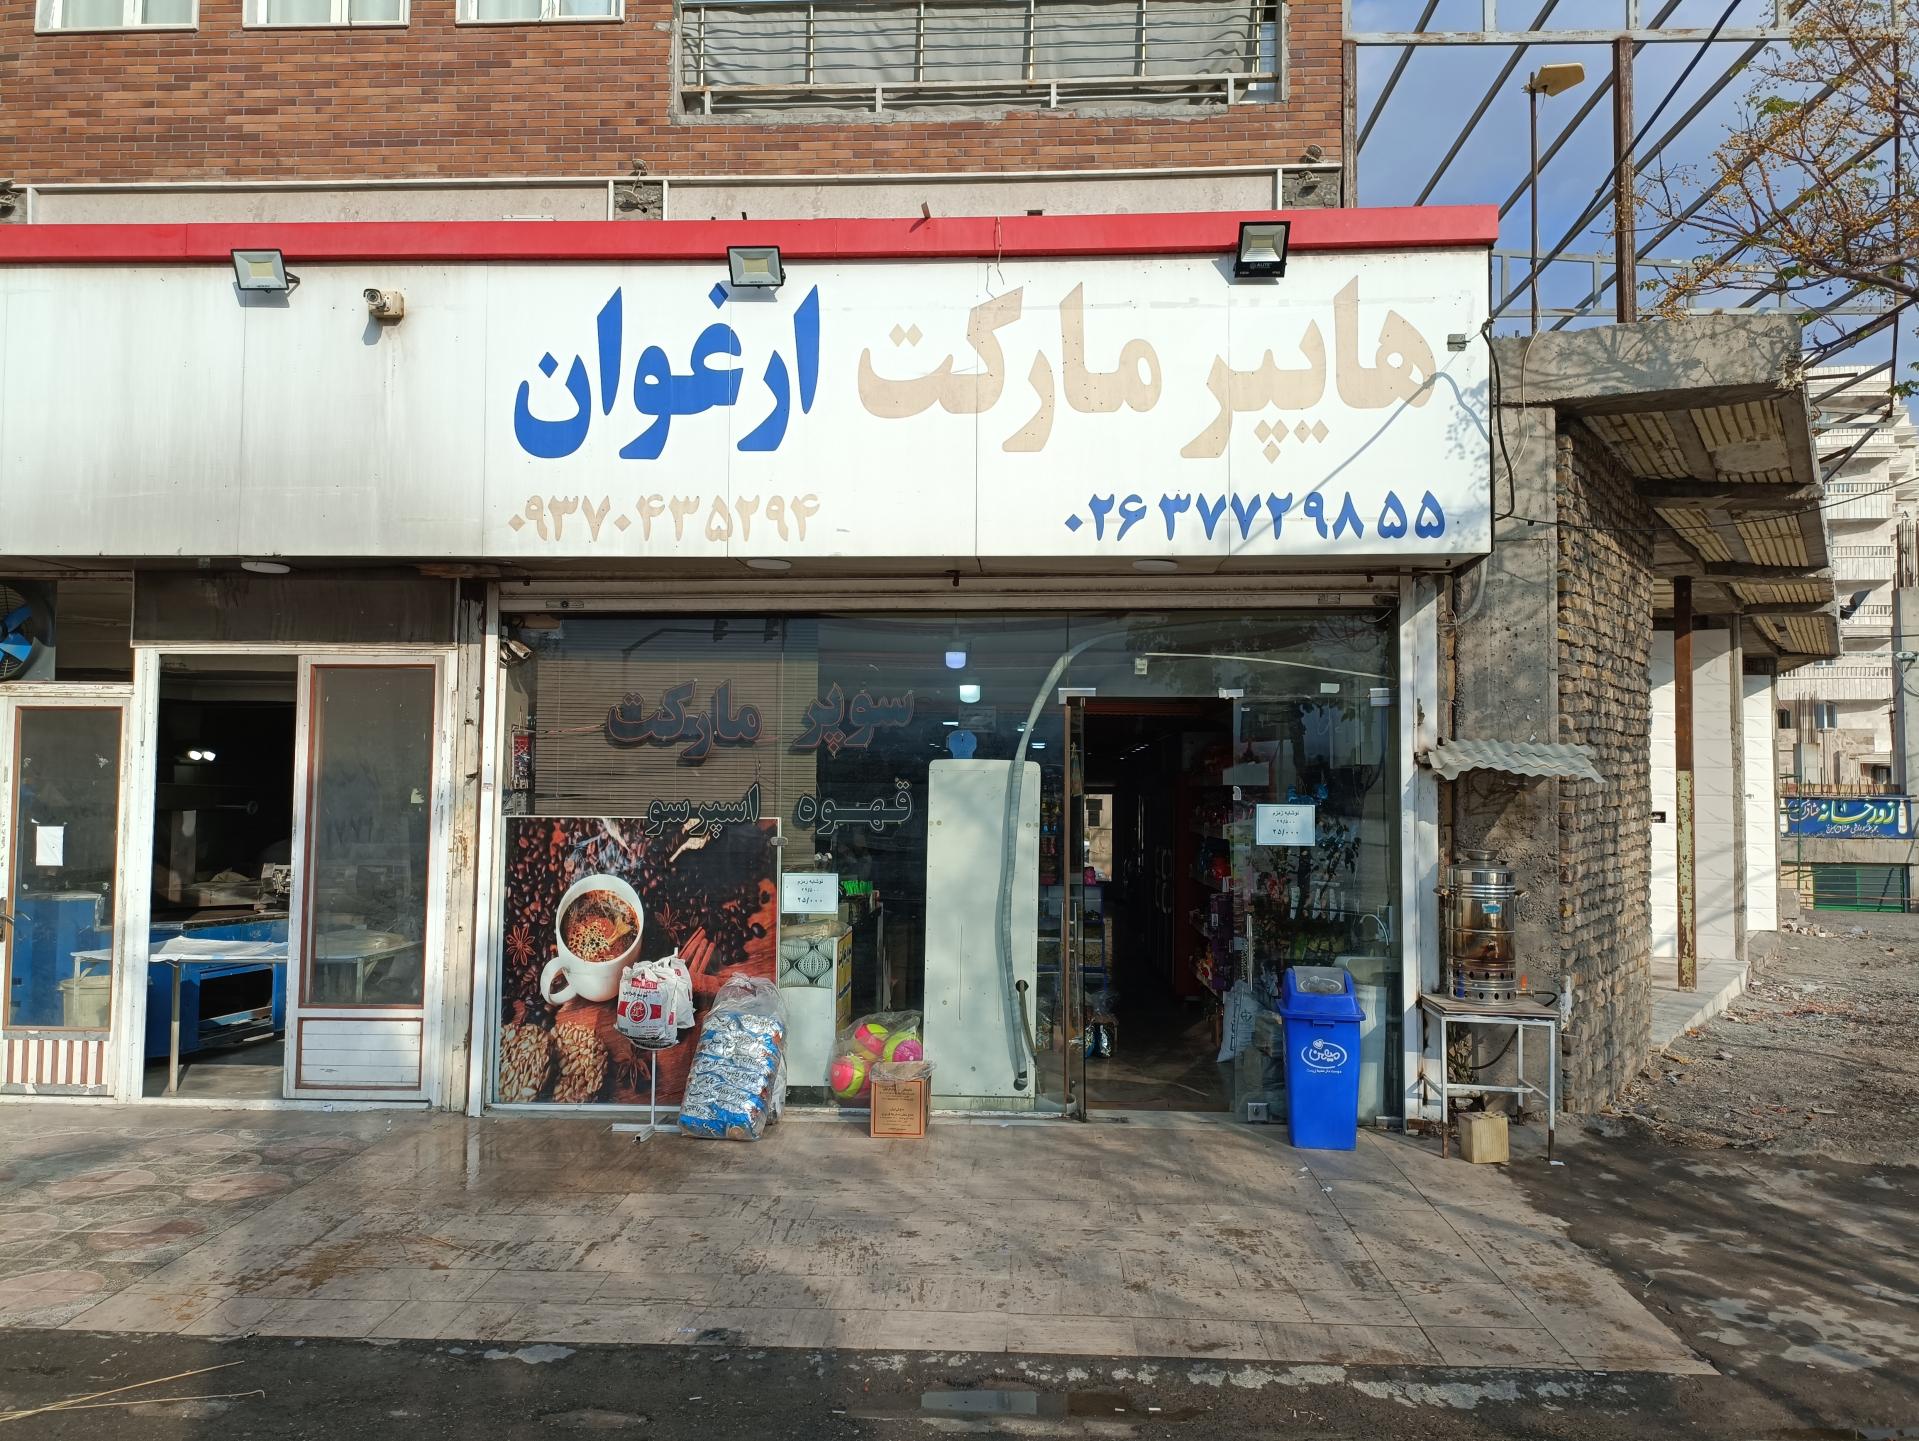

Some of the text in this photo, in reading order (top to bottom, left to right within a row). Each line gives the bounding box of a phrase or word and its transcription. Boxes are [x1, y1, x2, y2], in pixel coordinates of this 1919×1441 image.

[514, 275, 1437, 464] هایپر مارکت ارغوان
[508, 493, 821, 542] ۰۹۳۷۰۴۳۵۲۹۴
[1064, 490, 1446, 542] ۰۲۶۳۷۷۲۹۸۵۵
[607, 679, 914, 760] سوپر مارکت
[644, 777, 912, 839] قهوه اسپرسو
[1308, 1048, 1341, 1062] میهن
